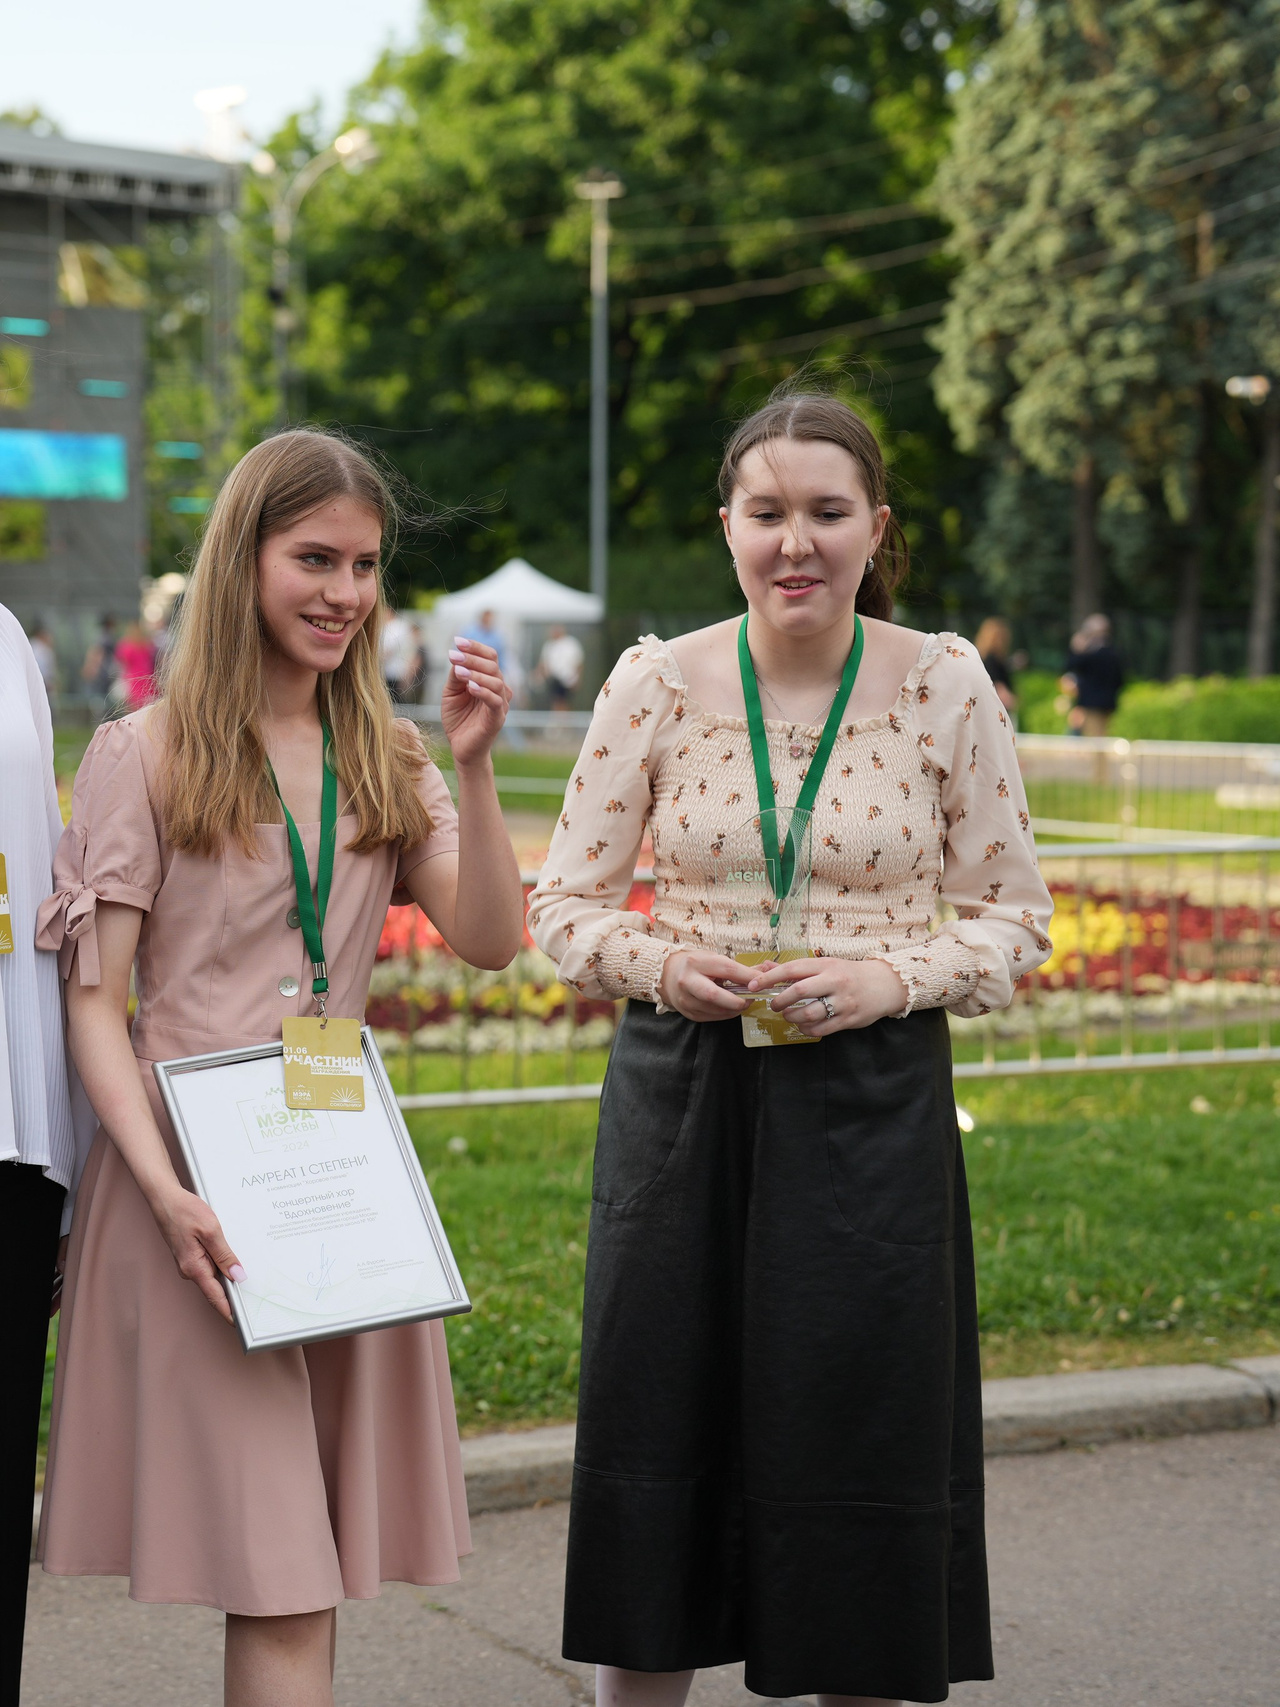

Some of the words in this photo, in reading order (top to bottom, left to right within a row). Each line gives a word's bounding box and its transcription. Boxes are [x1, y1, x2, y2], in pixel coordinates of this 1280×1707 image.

[283, 1046, 308, 1054] 01.06
[283, 1054, 363, 1067] УЧАСТНИК
[256, 1109, 315, 1129] МЭРА
[260, 1120, 319, 1139] МОСКВЫ
[282, 1141, 310, 1152] 2024
[241, 1167, 297, 1188] ЛАУРЕАТ
[308, 1154, 369, 1175] СТЕПЕНИ
[271, 1191, 335, 1210] Концертный
[336, 1188, 356, 1198] хор
